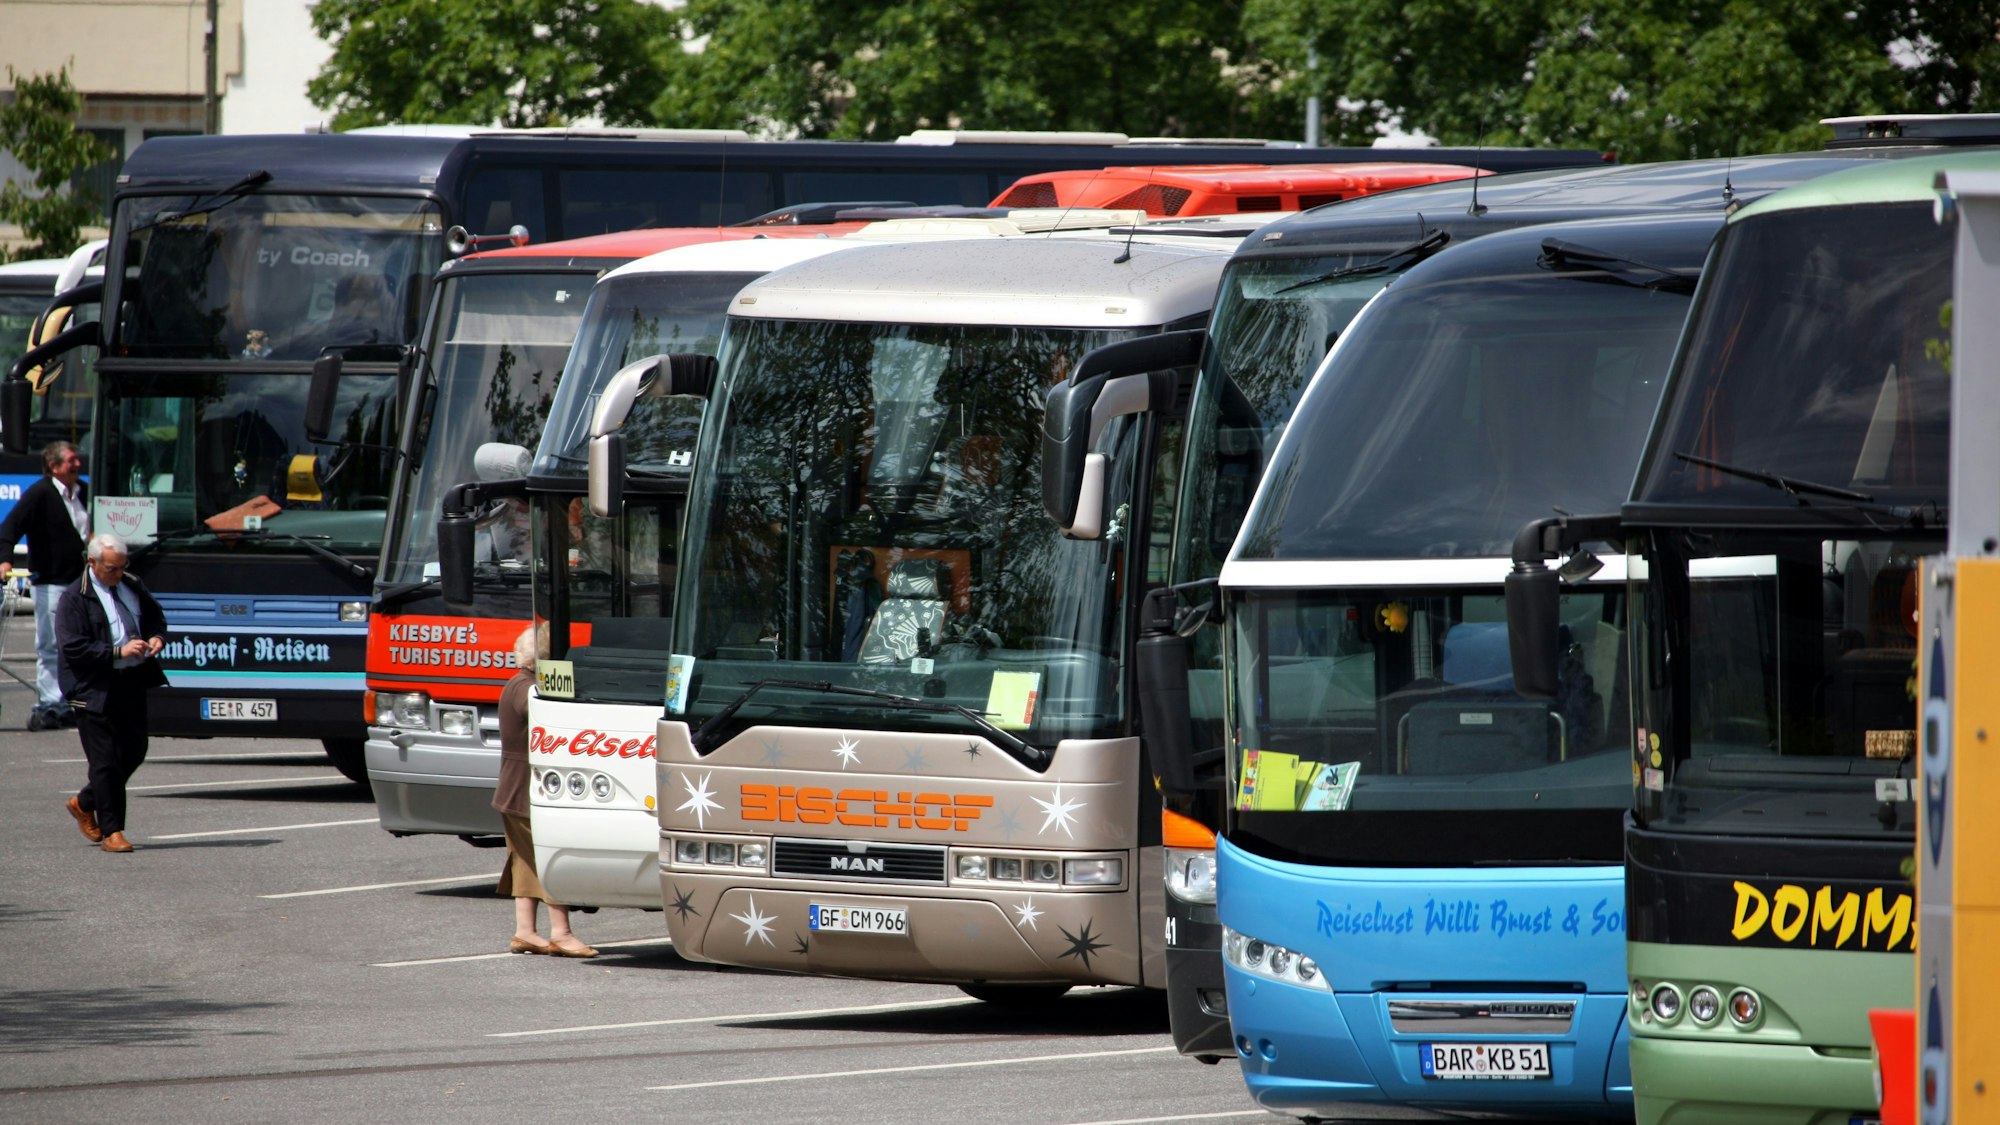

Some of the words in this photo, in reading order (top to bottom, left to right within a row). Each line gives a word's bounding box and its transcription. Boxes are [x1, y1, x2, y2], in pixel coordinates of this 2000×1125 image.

[257, 248, 282, 268] ty
[290, 246, 370, 268] Coach
[0, 484, 21, 500] en
[155, 636, 237, 667] andgraf
[254, 637, 331, 662] Reisen
[389, 647, 518, 669] TURISTBUSSE
[541, 667, 572, 693] edom
[210, 702, 226, 717] EE
[236, 703, 244, 717] R
[250, 703, 273, 718] 457
[529, 726, 569, 754] Der
[569, 729, 657, 759] Elset
[831, 856, 884, 872] MAN
[820, 909, 839, 927] GF
[851, 910, 871, 929] CM
[875, 912, 904, 931] 966
[1316, 899, 1413, 938] Reiselust
[1424, 898, 1479, 936] Willi
[1490, 898, 1552, 939] Brust
[1562, 903, 1580, 937] &
[1165, 916, 1176, 945] 41
[1434, 1048, 1475, 1071] BAR
[1488, 1048, 1516, 1071] KB
[1520, 1049, 1547, 1071] 51
